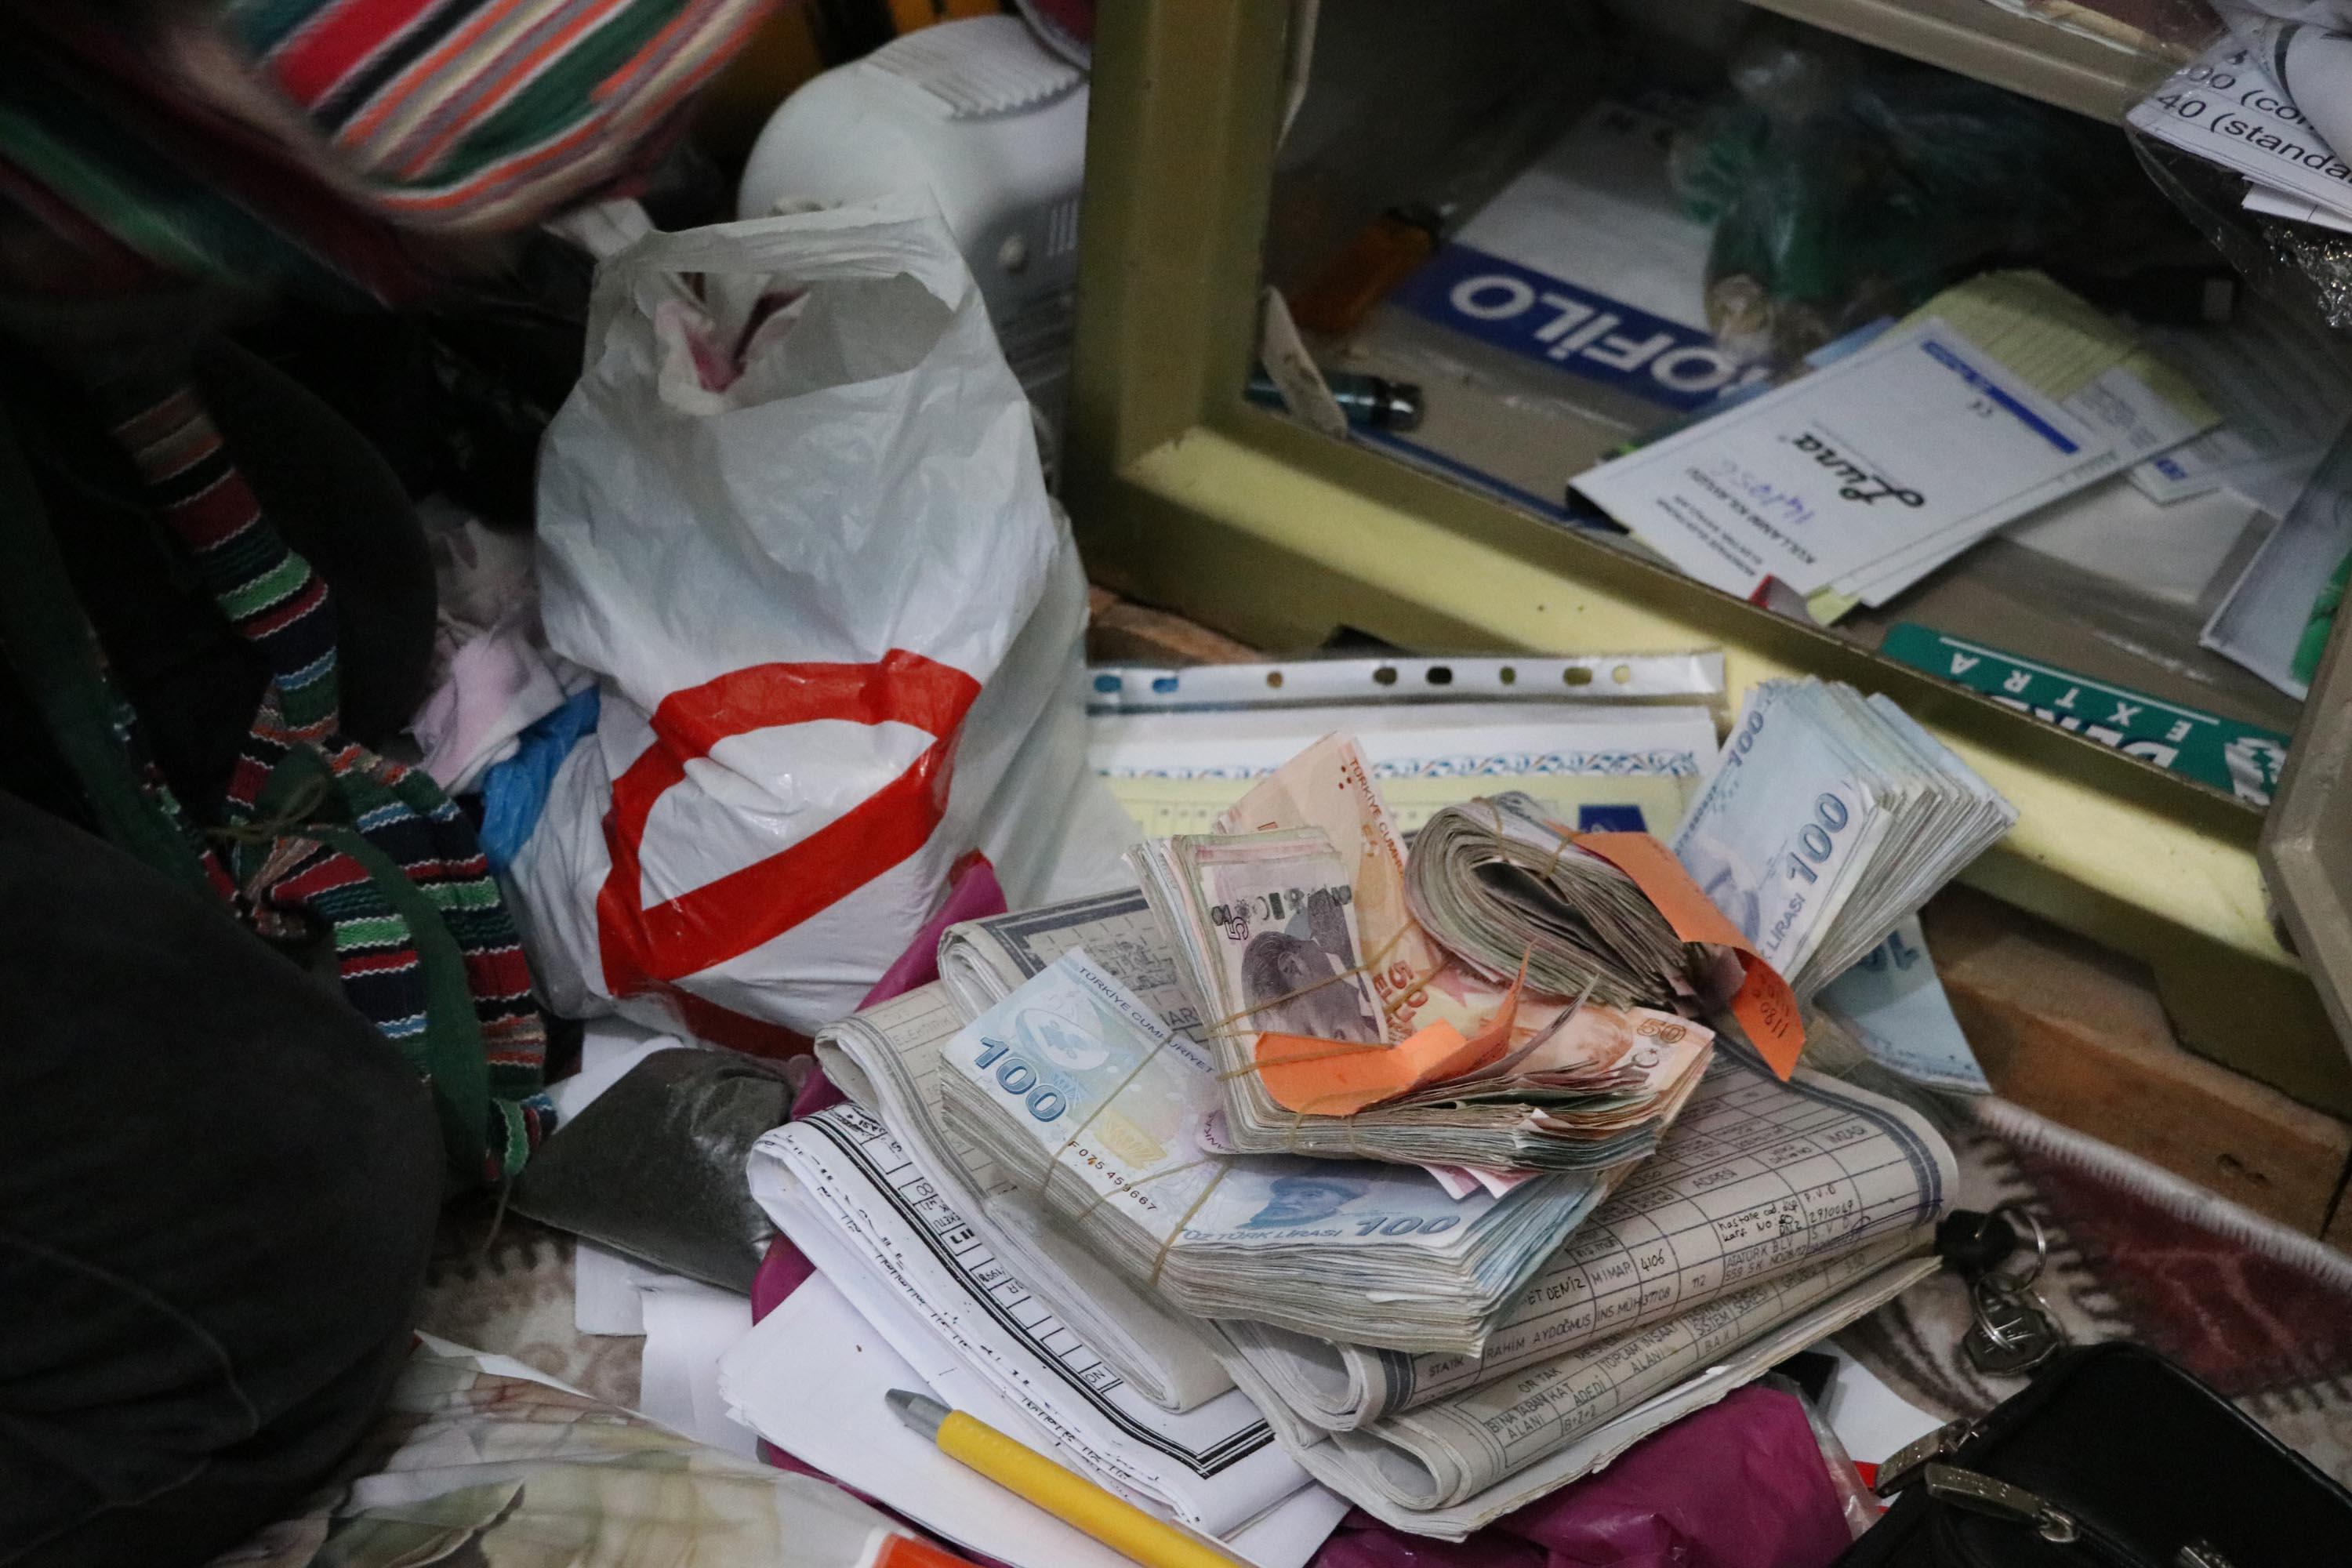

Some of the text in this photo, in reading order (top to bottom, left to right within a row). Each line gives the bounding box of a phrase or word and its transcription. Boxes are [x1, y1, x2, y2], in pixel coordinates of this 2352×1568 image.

[2210, 112, 2352, 184] (standa
[1950, 652, 2194, 742] EXTRA
[1727, 710, 1764, 768] 100
[1785, 792, 1849, 886] 100
[1079, 966, 1131, 1012] TÜRKİYE
[1635, 1018, 1687, 1044] 50
[974, 1035, 1068, 1124] 100
[1355, 1214, 1462, 1238] 100
